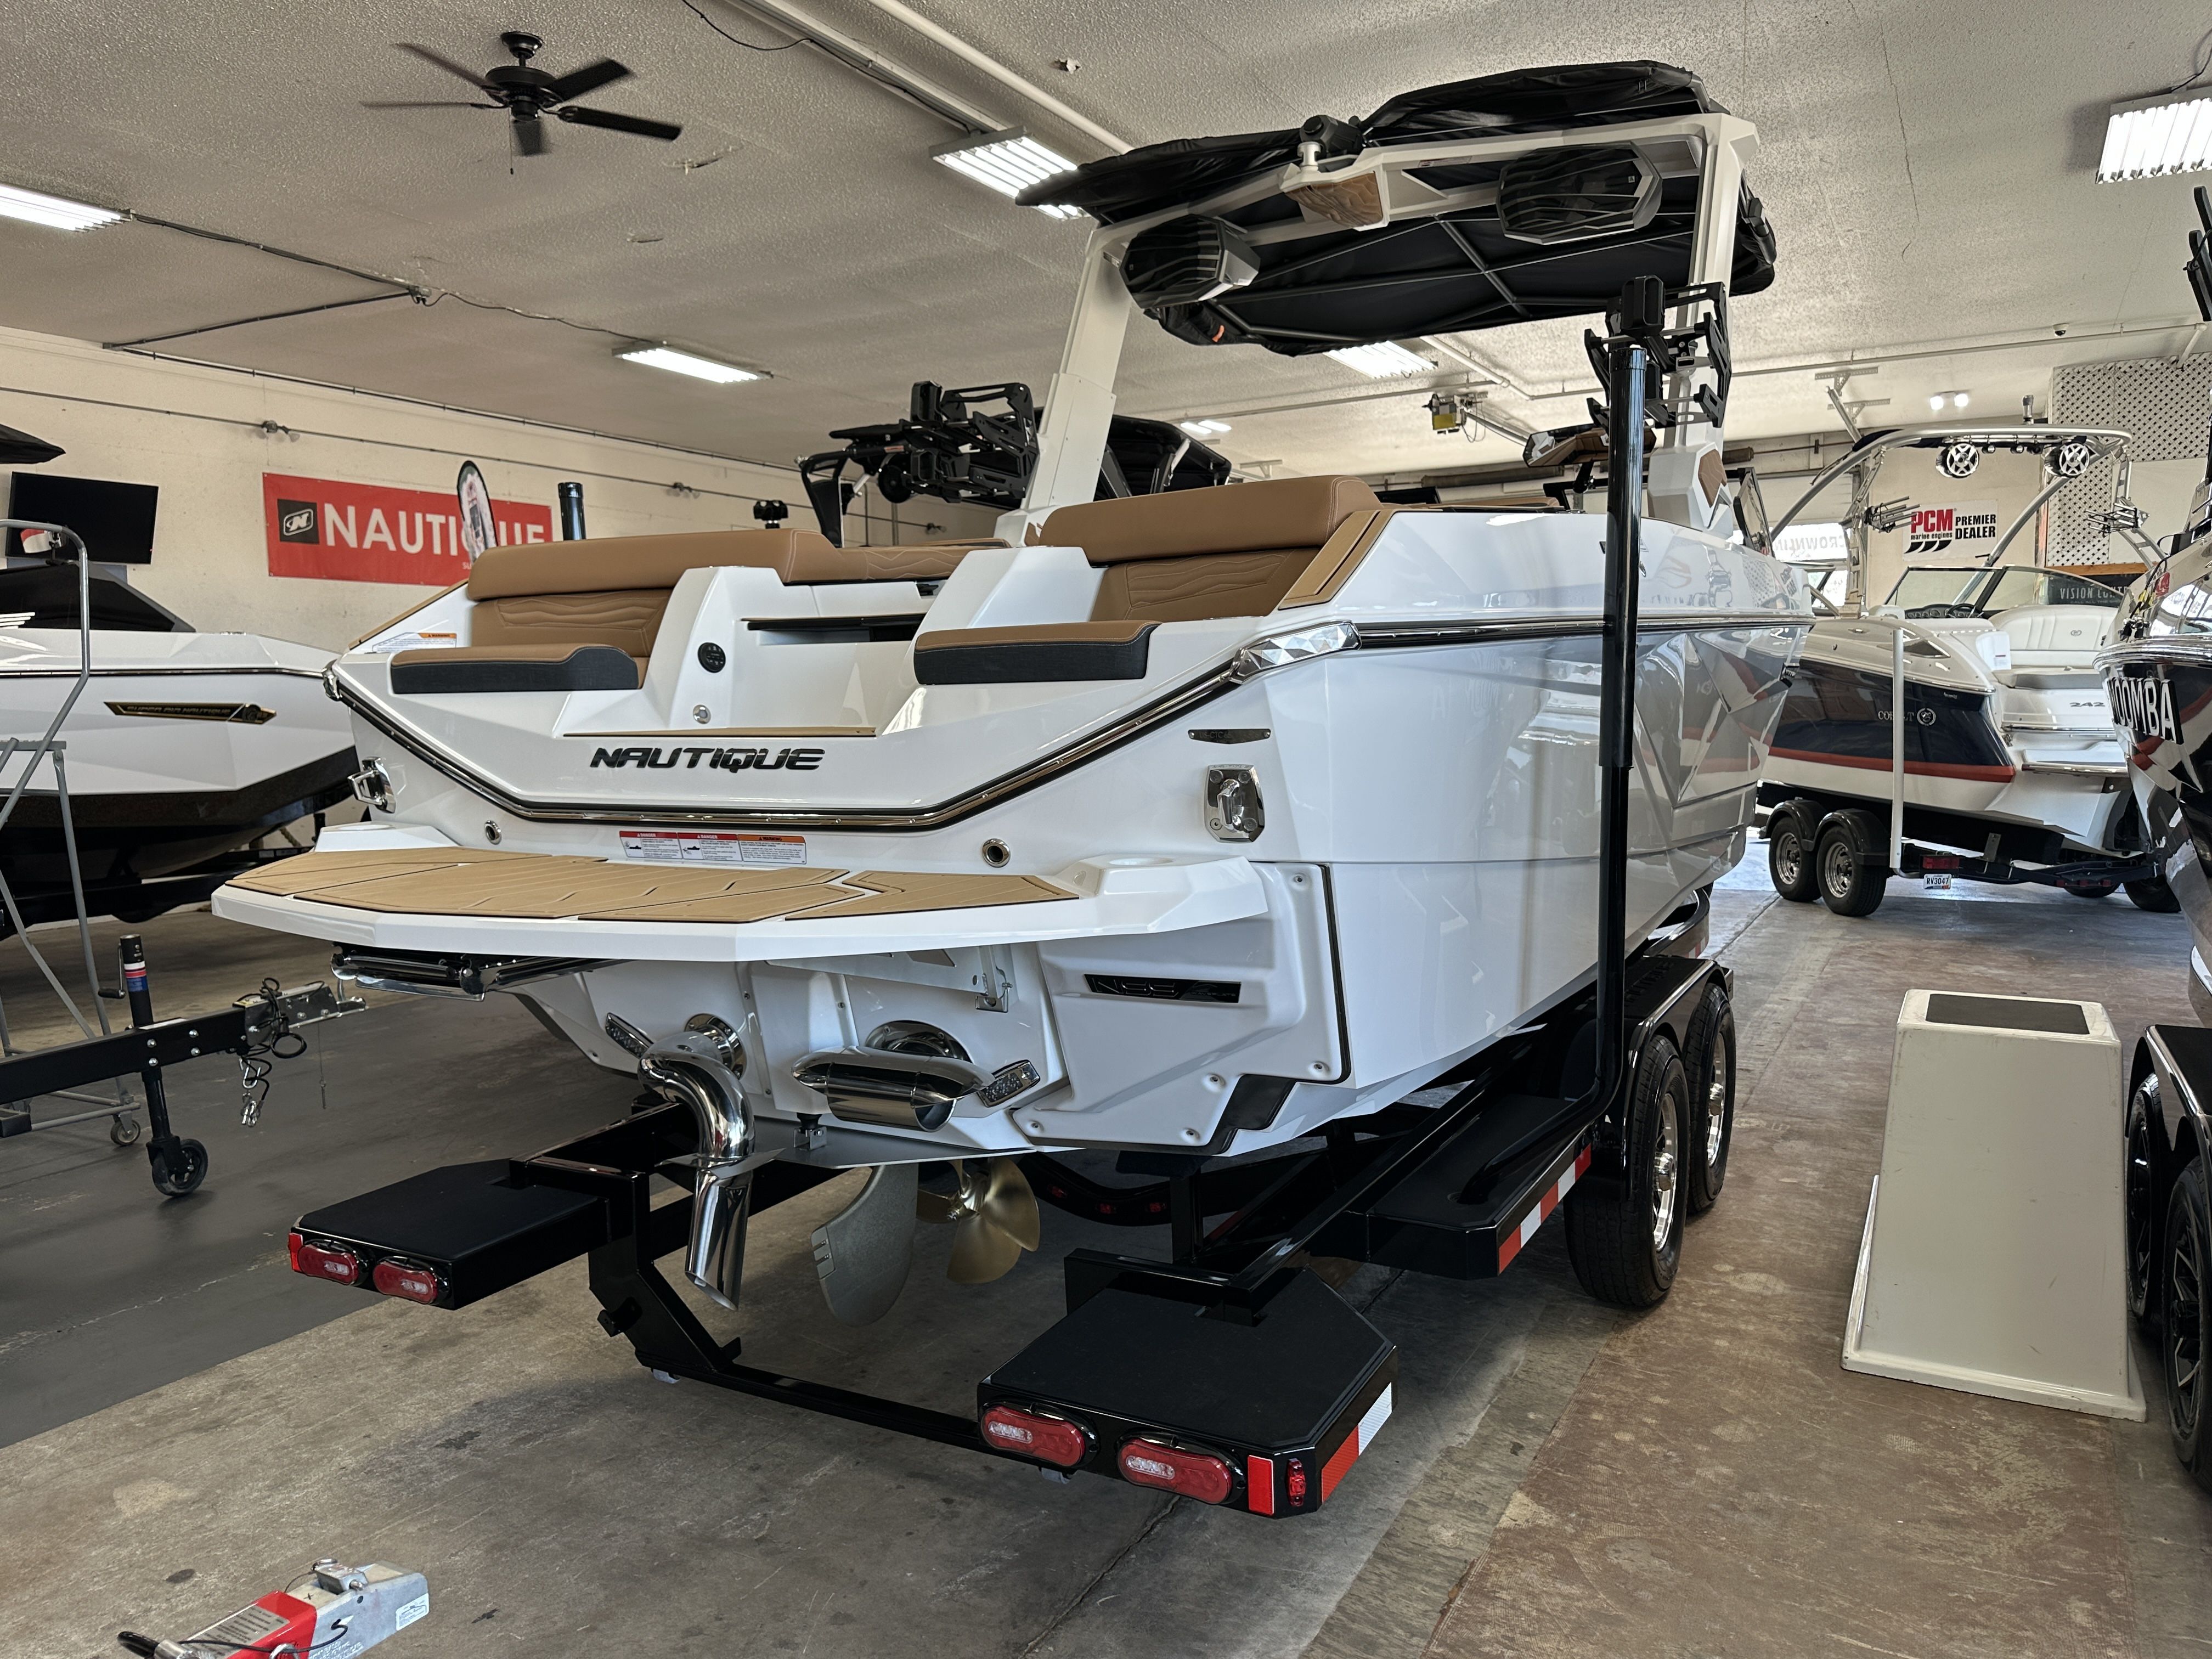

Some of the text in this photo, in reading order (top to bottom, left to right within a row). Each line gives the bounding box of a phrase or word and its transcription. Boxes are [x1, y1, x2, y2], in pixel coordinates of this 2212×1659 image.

[1911, 509, 1953, 533] PCM
[1955, 514, 1996, 526] PREMIER
[324, 503, 545, 556] NAUTIUE
[1955, 526, 1995, 539] DEALER
[2060, 588, 2093, 600] VISION
[590, 747, 825, 773] NAUTIQUE
